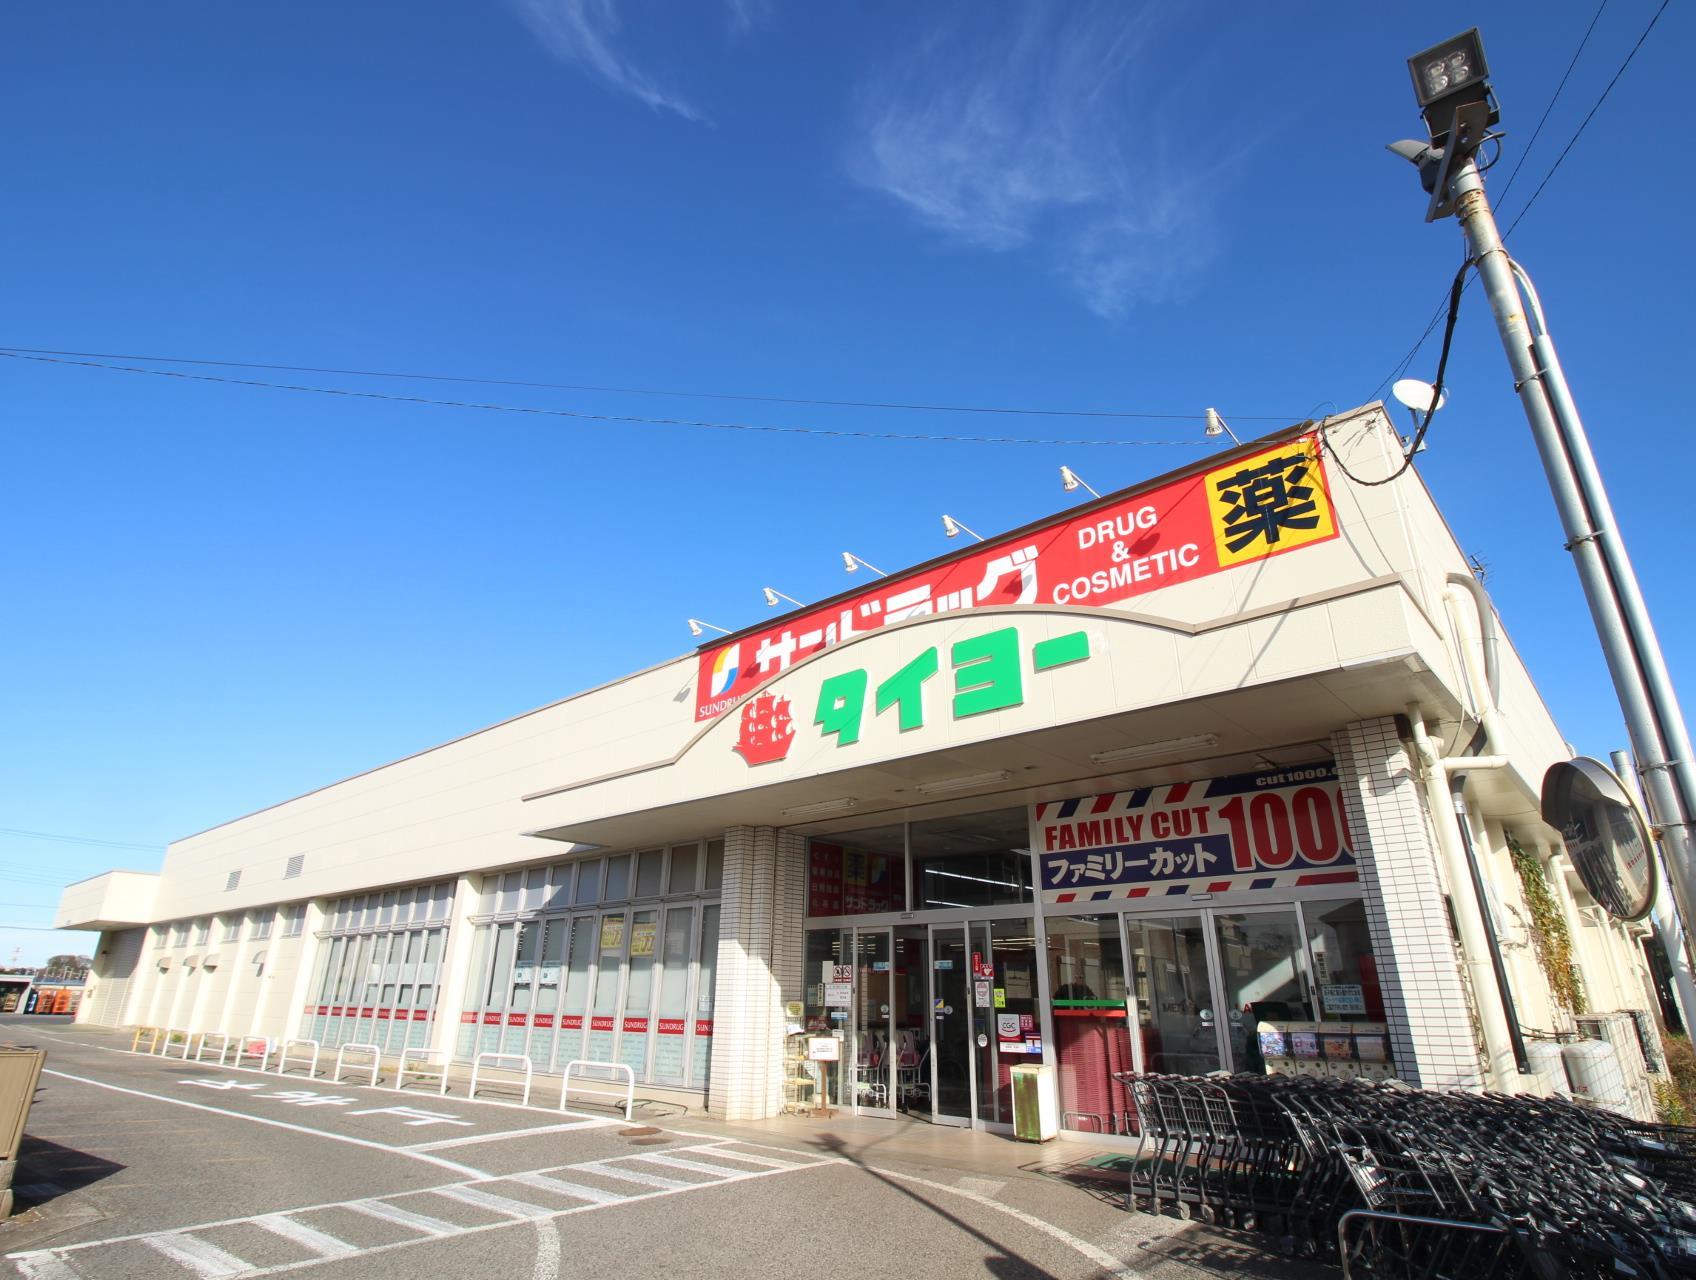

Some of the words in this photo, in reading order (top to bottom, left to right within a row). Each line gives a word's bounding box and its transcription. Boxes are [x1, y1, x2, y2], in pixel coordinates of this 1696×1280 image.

[1216, 453, 1320, 554] 薬
[1078, 506, 1158, 550] DRUG
[1111, 540, 1130, 563] &
[1052, 543, 1200, 605] COSMETIC
[813, 626, 1091, 748] タイヨー
[1044, 814, 1145, 852] FAMILY
[1150, 804, 1211, 839] CUT
[1218, 786, 1355, 869] 100
[1047, 842, 1218, 886] ファミリーカット
[658, 1022, 684, 1032] SUNDRUG
